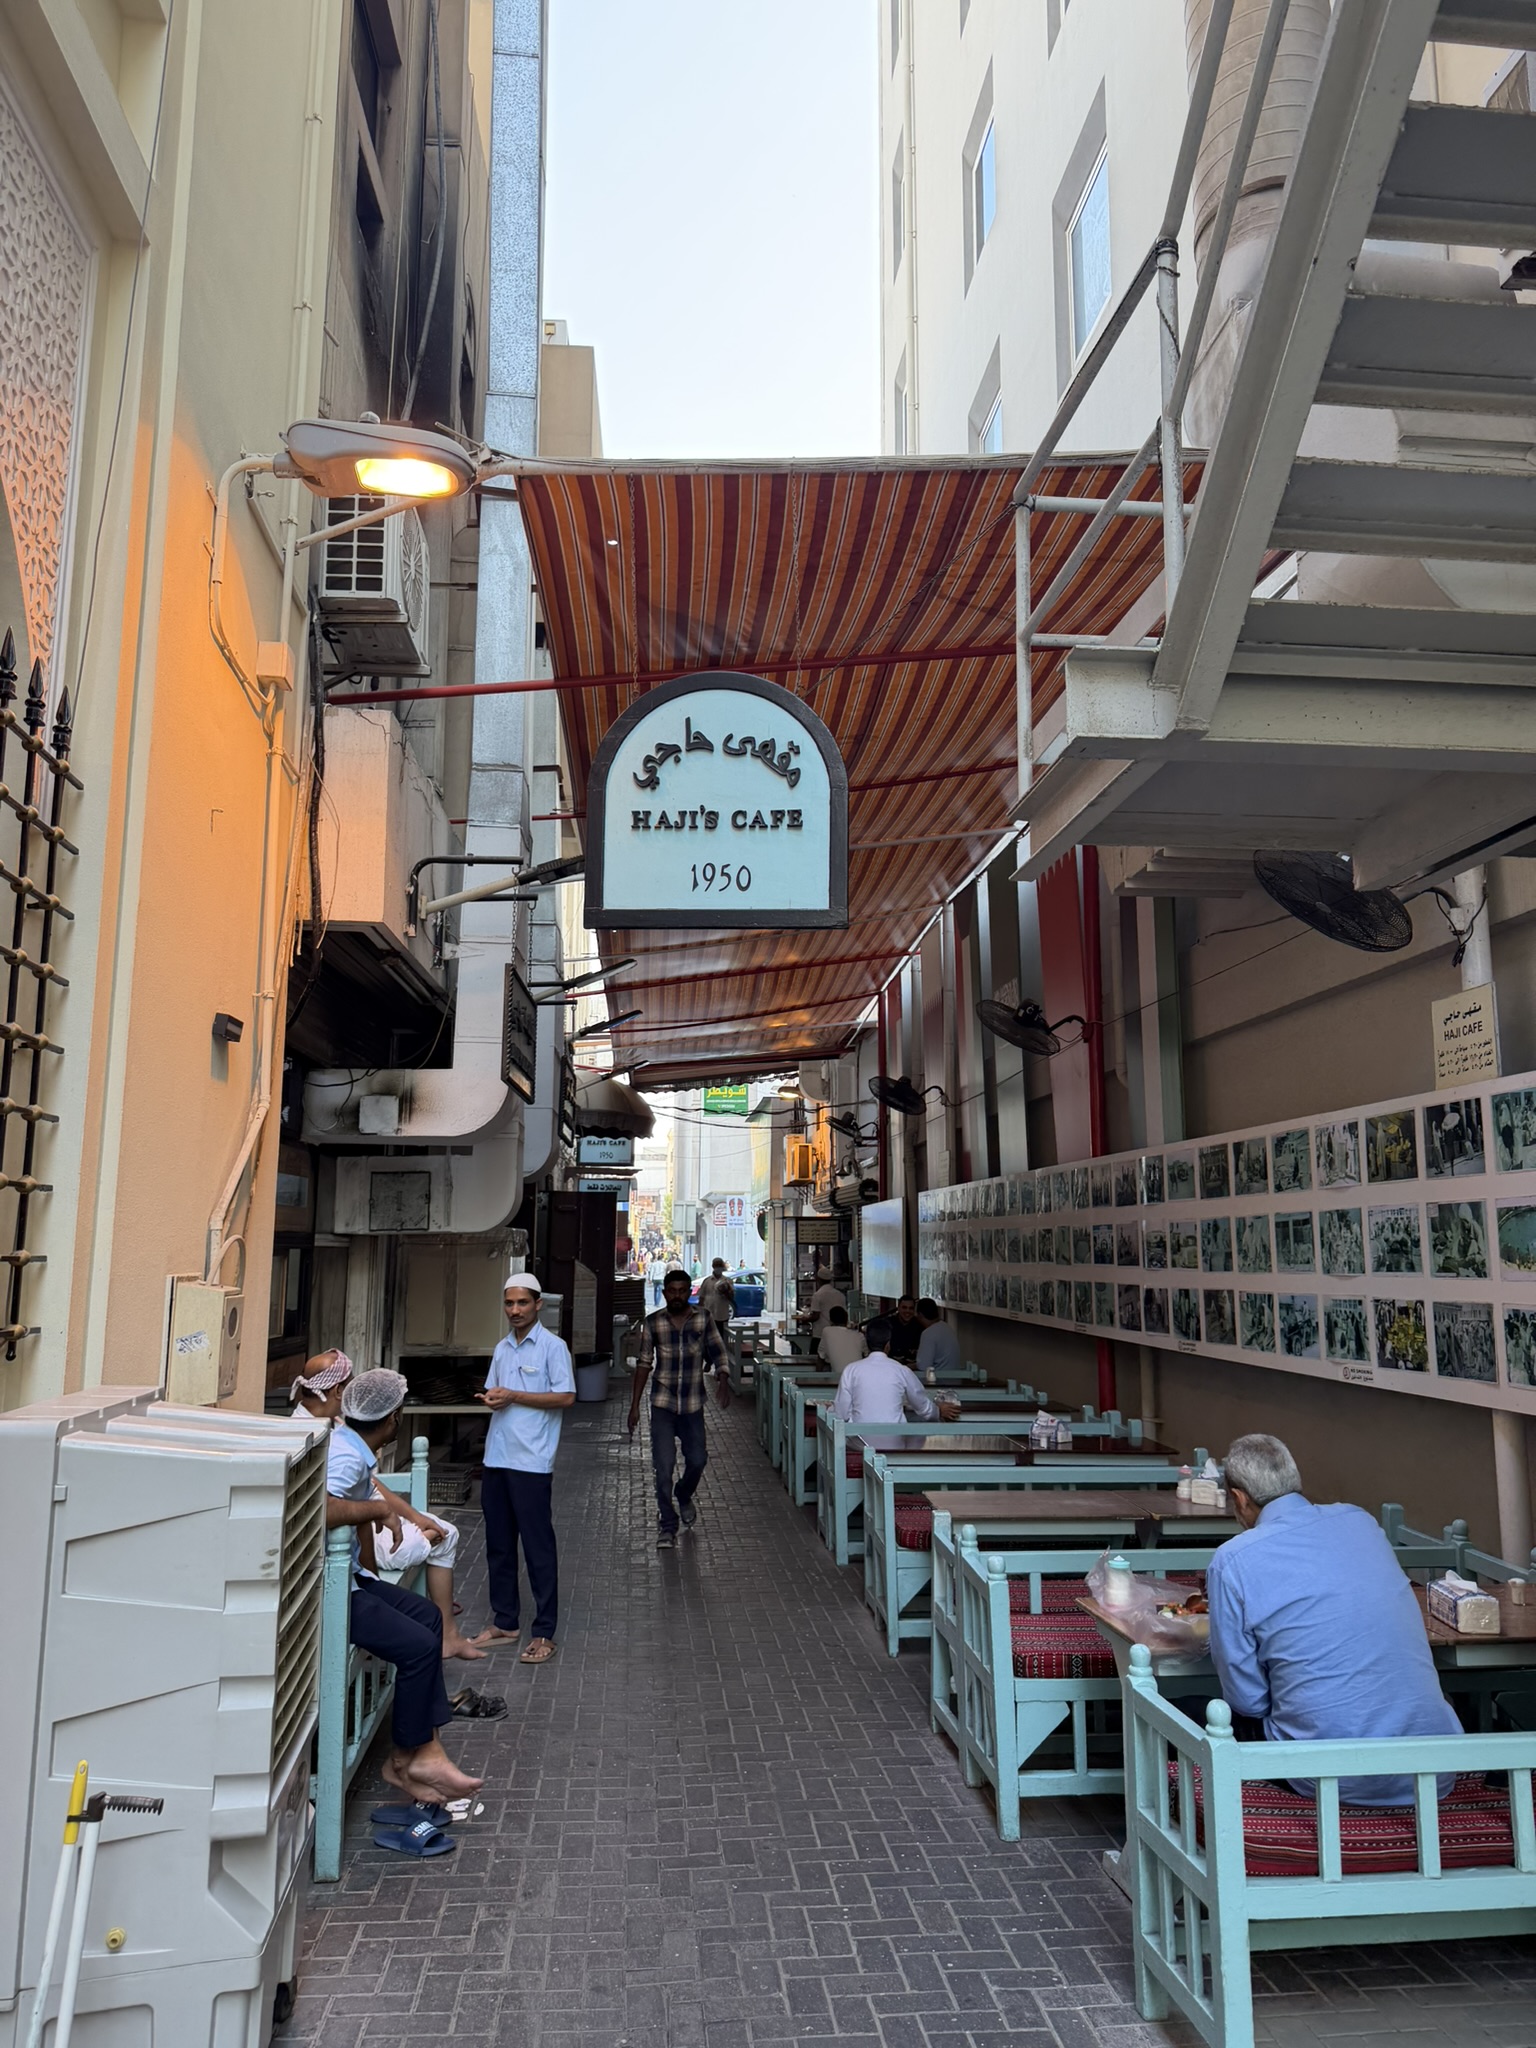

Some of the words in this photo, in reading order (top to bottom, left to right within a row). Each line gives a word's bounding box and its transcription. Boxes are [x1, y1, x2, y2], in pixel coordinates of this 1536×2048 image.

[632, 716, 714, 790] حاجي
[722, 733, 801, 788] مقهى
[631, 804, 719, 829] HAJI'S
[731, 809, 803, 829] CAFE
[691, 862, 752, 892] 1950
[1443, 1027, 1461, 1041] HAJI
[1462, 1020, 1483, 1036] CAFE
